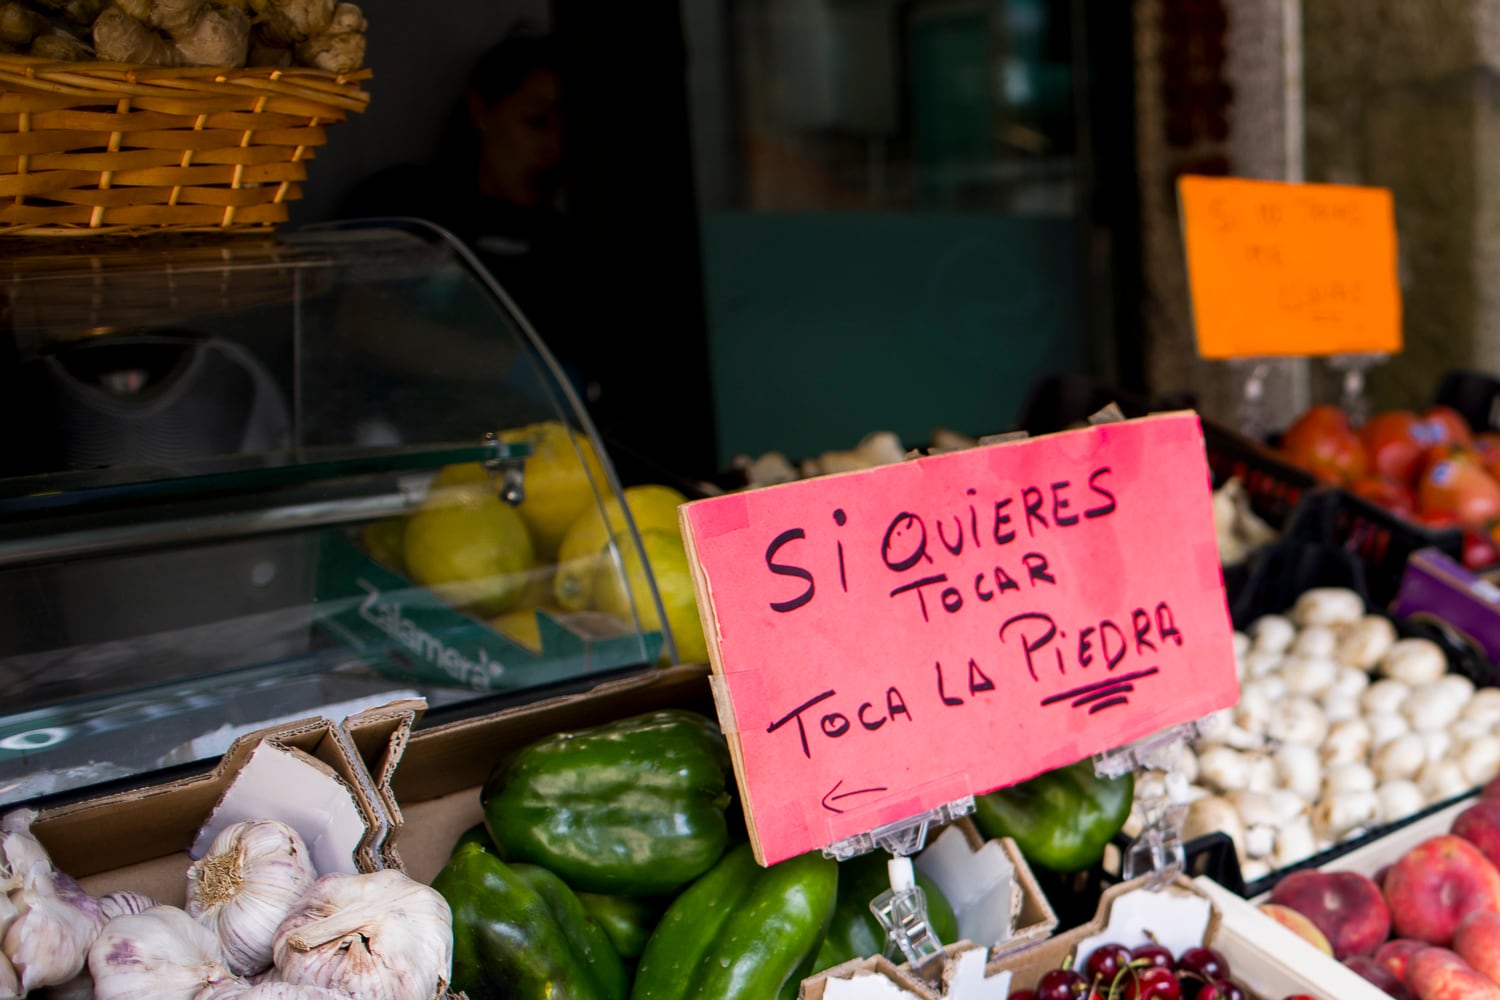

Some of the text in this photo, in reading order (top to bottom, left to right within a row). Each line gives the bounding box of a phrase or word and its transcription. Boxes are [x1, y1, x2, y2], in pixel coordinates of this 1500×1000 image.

[890, 552, 1056, 622] TOCAR
[766, 689, 912, 759] TOCA
[936, 658, 995, 706] LA
